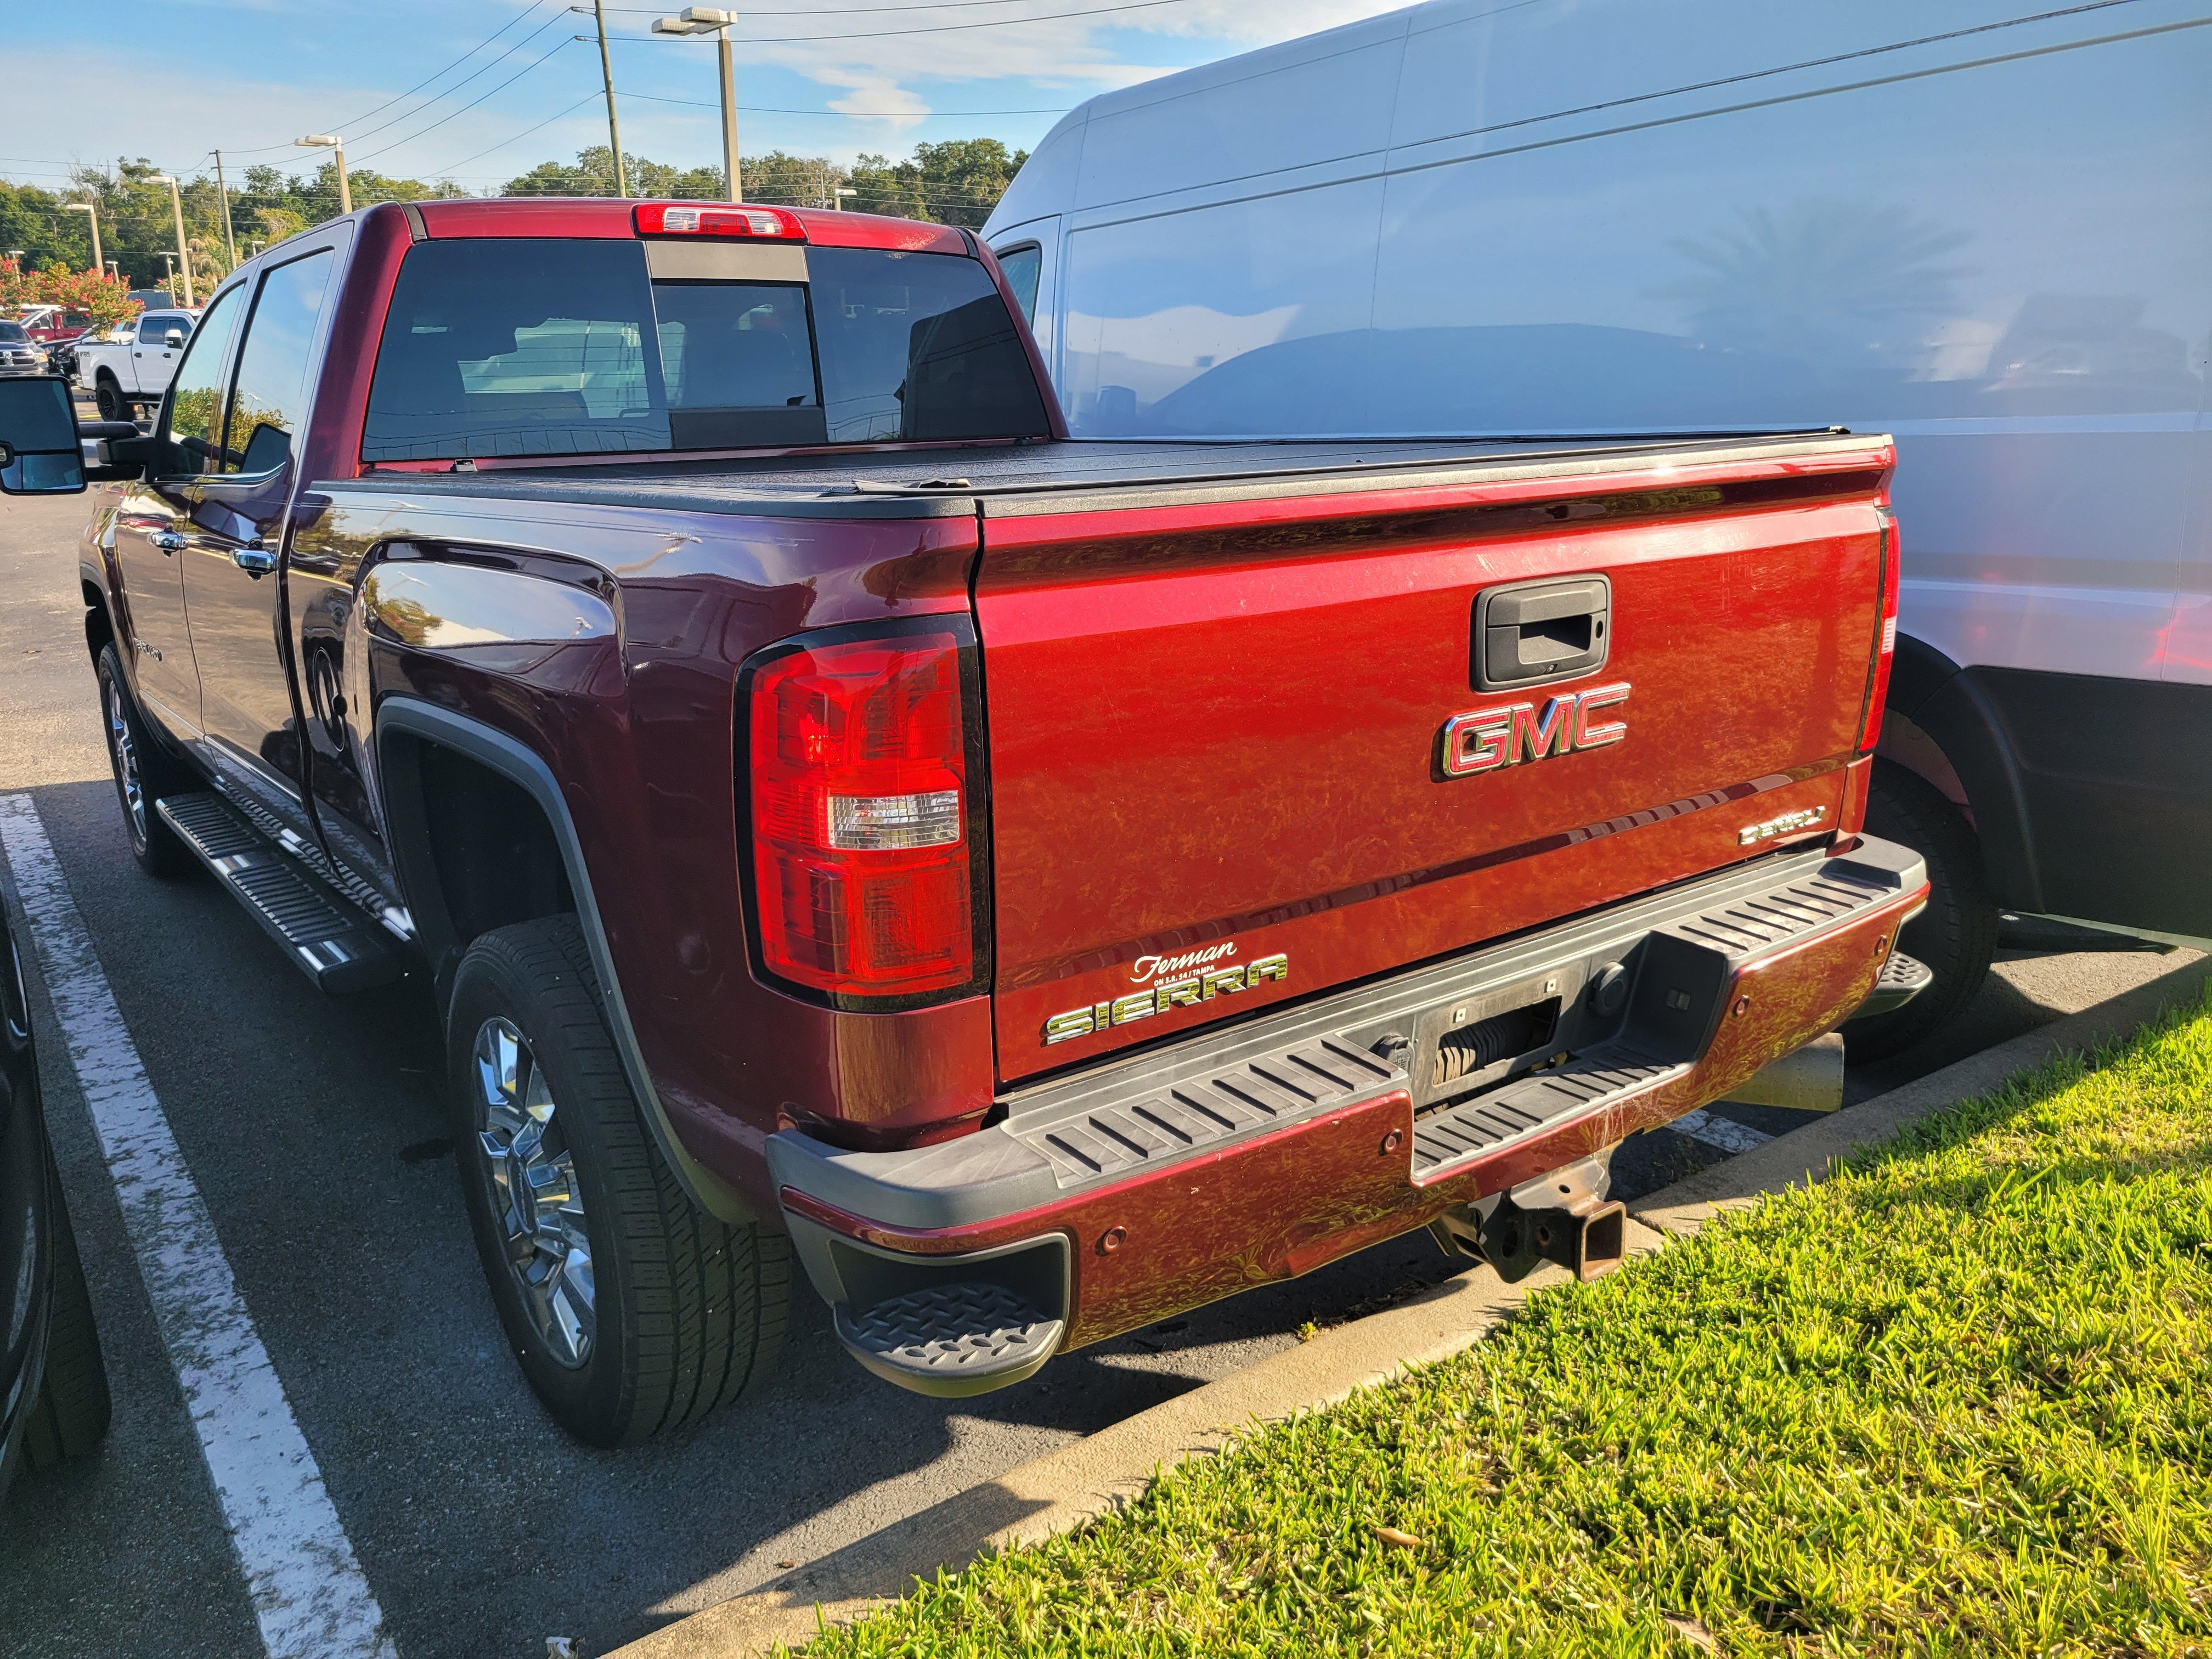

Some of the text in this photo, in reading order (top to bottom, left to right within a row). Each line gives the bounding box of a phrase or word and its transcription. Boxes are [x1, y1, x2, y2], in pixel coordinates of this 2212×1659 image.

[1442, 682, 1631, 778] GMC
[1130, 941, 1238, 983] Ferman
[1154, 978, 1164, 986] ON
[1165, 975, 1178, 984] S.R.
[1178, 971, 1188, 980] 54
[1192, 964, 1215, 977] TAMPA
[1046, 953, 1288, 1046] SIERRA
